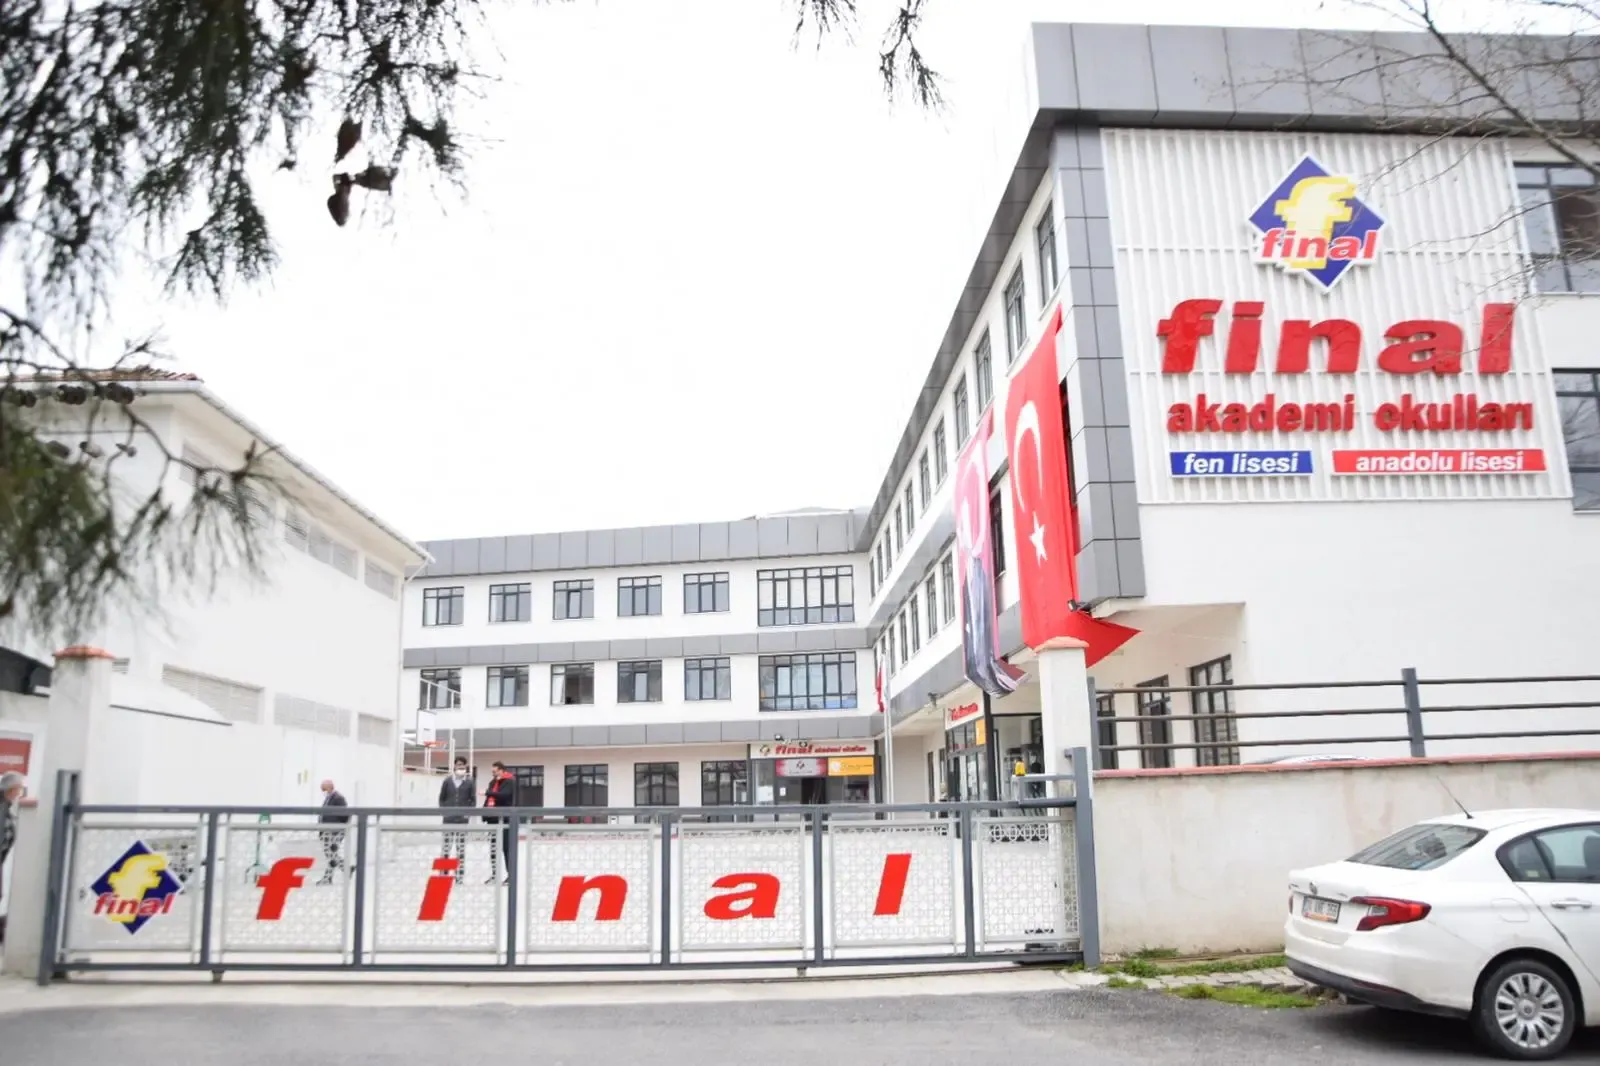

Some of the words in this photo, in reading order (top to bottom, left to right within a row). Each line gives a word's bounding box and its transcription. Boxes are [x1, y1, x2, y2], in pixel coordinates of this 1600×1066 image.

[1261, 228, 1378, 259] final
[1156, 299, 1516, 374] final
[1167, 393, 1355, 433] akademi
[1184, 453, 1225, 474] fen
[1231, 452, 1299, 473] lisesi
[1356, 451, 1454, 472] anadolu
[1460, 450, 1524, 471] lisesi
[93, 894, 176, 914] final
